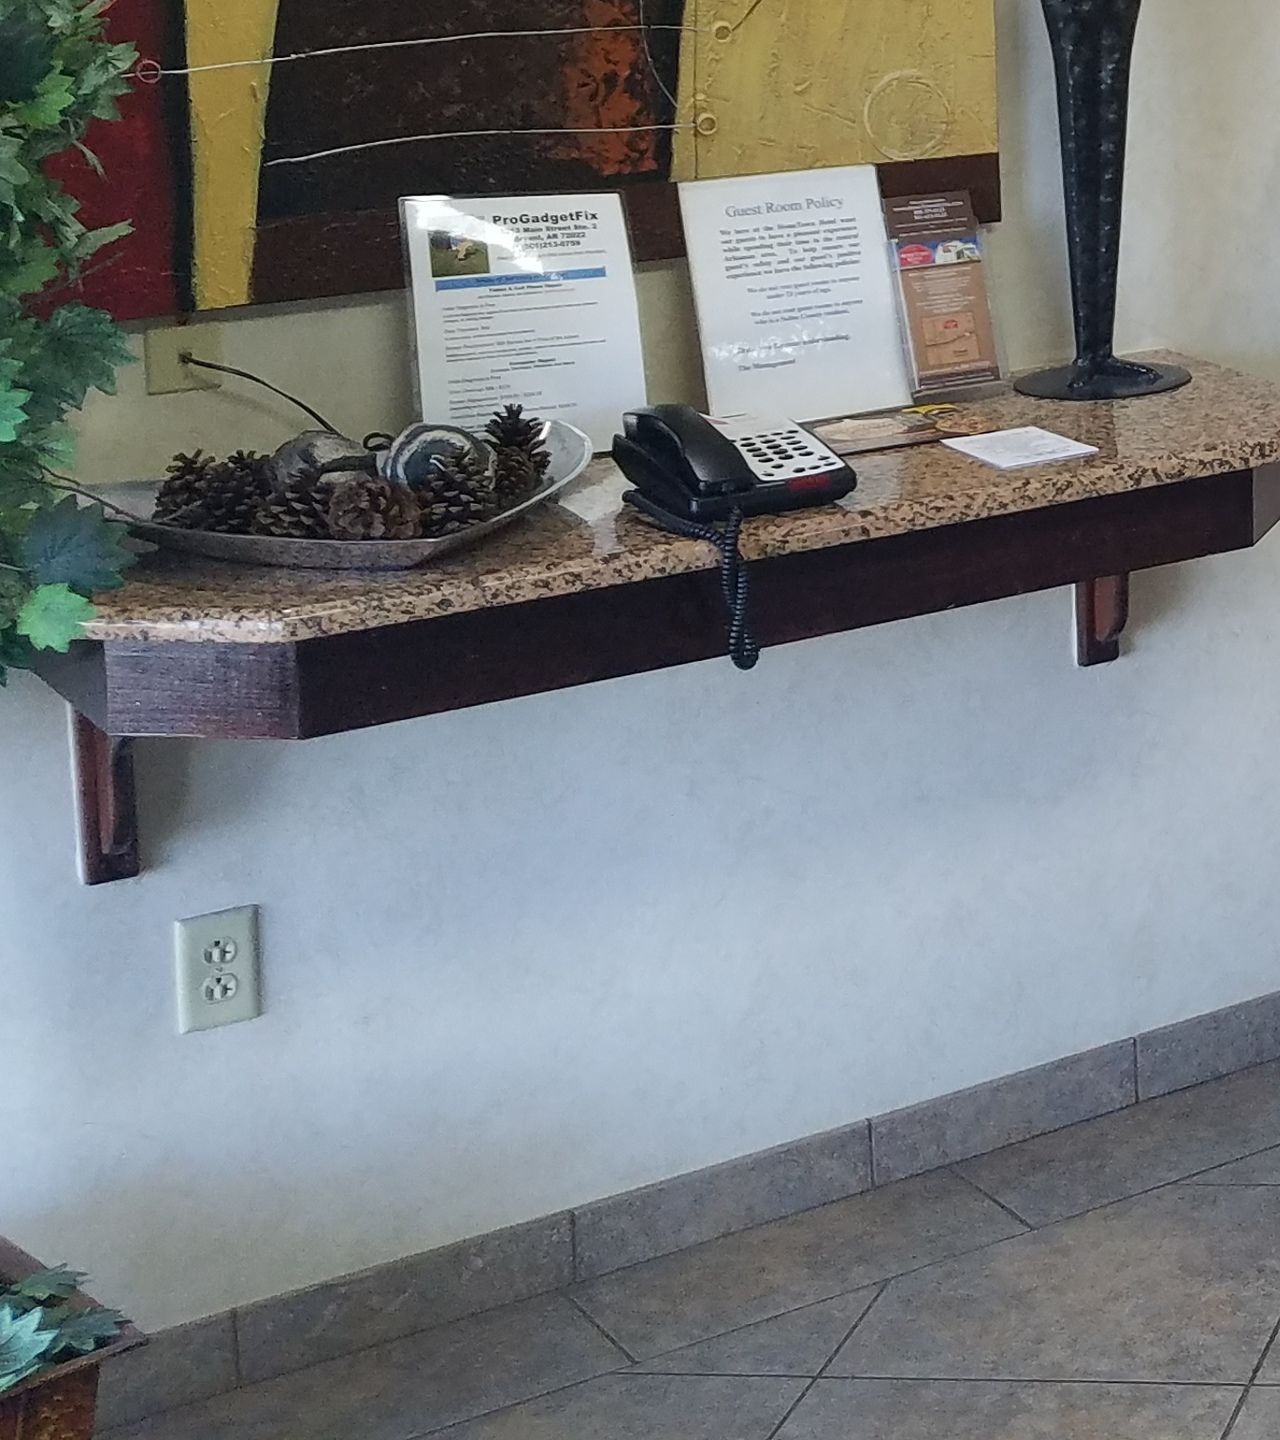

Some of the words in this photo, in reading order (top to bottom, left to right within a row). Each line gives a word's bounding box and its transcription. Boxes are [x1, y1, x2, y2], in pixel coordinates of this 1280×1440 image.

[725, 205, 762, 218] Guest
[766, 202, 802, 214] Room
[805, 197, 843, 210] Policy
[492, 210, 599, 225] ProGadgetFix
